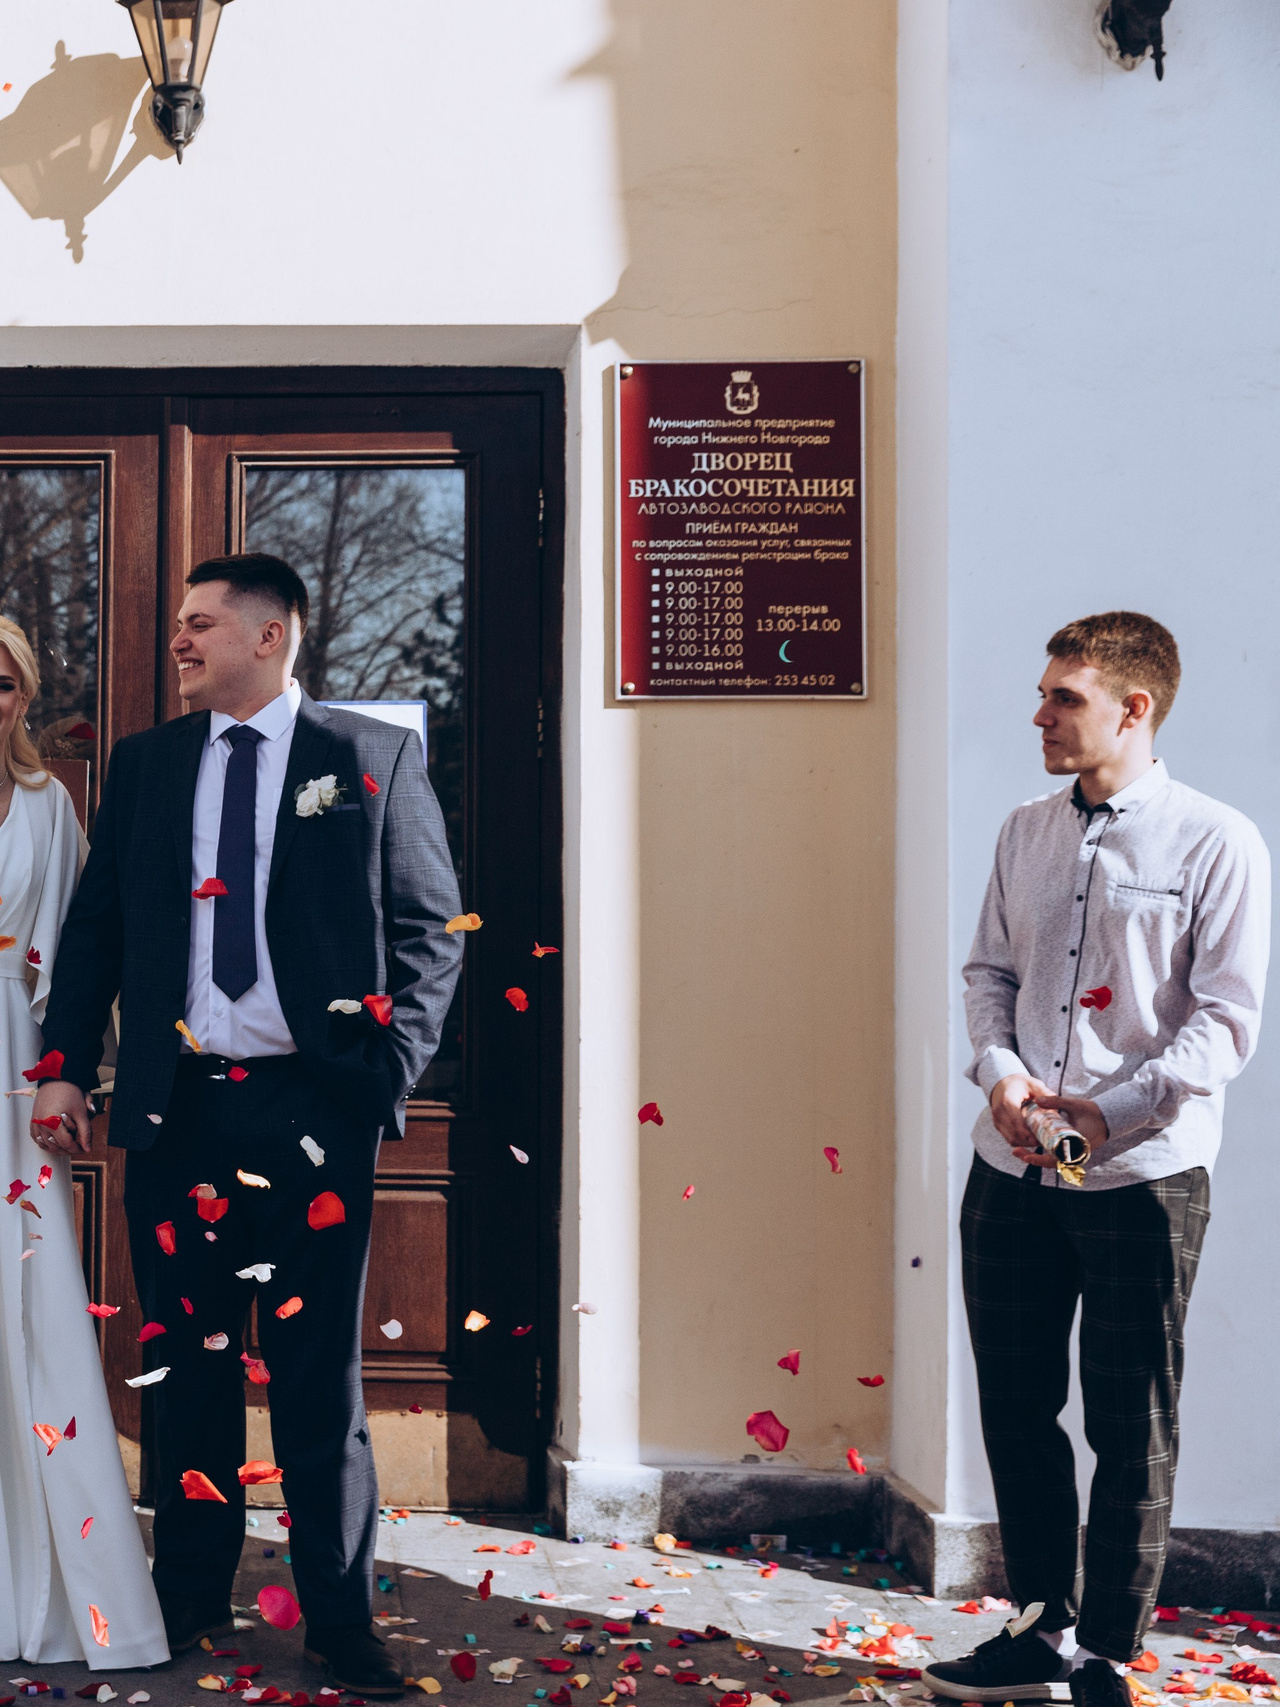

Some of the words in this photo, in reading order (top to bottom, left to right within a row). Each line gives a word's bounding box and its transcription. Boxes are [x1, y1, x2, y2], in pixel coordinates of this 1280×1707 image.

[648, 417, 751, 431] Муниципальное
[754, 419, 835, 431] предприятие
[653, 435, 699, 447] города
[702, 432, 758, 444] Нижнего
[761, 432, 830, 447] Новгорода
[691, 452, 793, 473] ДВОРЕЦ
[628, 478, 855, 498] БРАКОСОЧЕТАНИЯ
[686, 520, 732, 534] ПРИЁМ
[735, 522, 798, 535] ГРАЖДАН
[632, 540, 646, 548] по
[649, 540, 703, 550] вопросам
[705, 539, 758, 547] оказания
[760, 539, 791, 550] услуг,
[793, 539, 852, 547] связанных
[634, 553, 642, 561] с
[644, 551, 739, 563] сопровождением
[741, 551, 812, 562] регистрации
[814, 549, 848, 562] брака
[665, 566, 743, 578] выходной
[665, 581, 743, 594] 9.00-17.00
[665, 597, 743, 610] 9.00-17.00
[769, 605, 828, 617] перерыв
[665, 612, 743, 625] 9.00-17.00
[757, 619, 841, 631] 13.00-14.00
[665, 628, 743, 641] 9.00-17.00
[665, 644, 743, 656] 9.00-16.00
[665, 660, 743, 672] выходной
[649, 677, 716, 686] контактный
[718, 675, 771, 688] телефон:
[775, 675, 798, 686] 253
[801, 675, 816, 685] 45
[819, 675, 835, 685] 02
